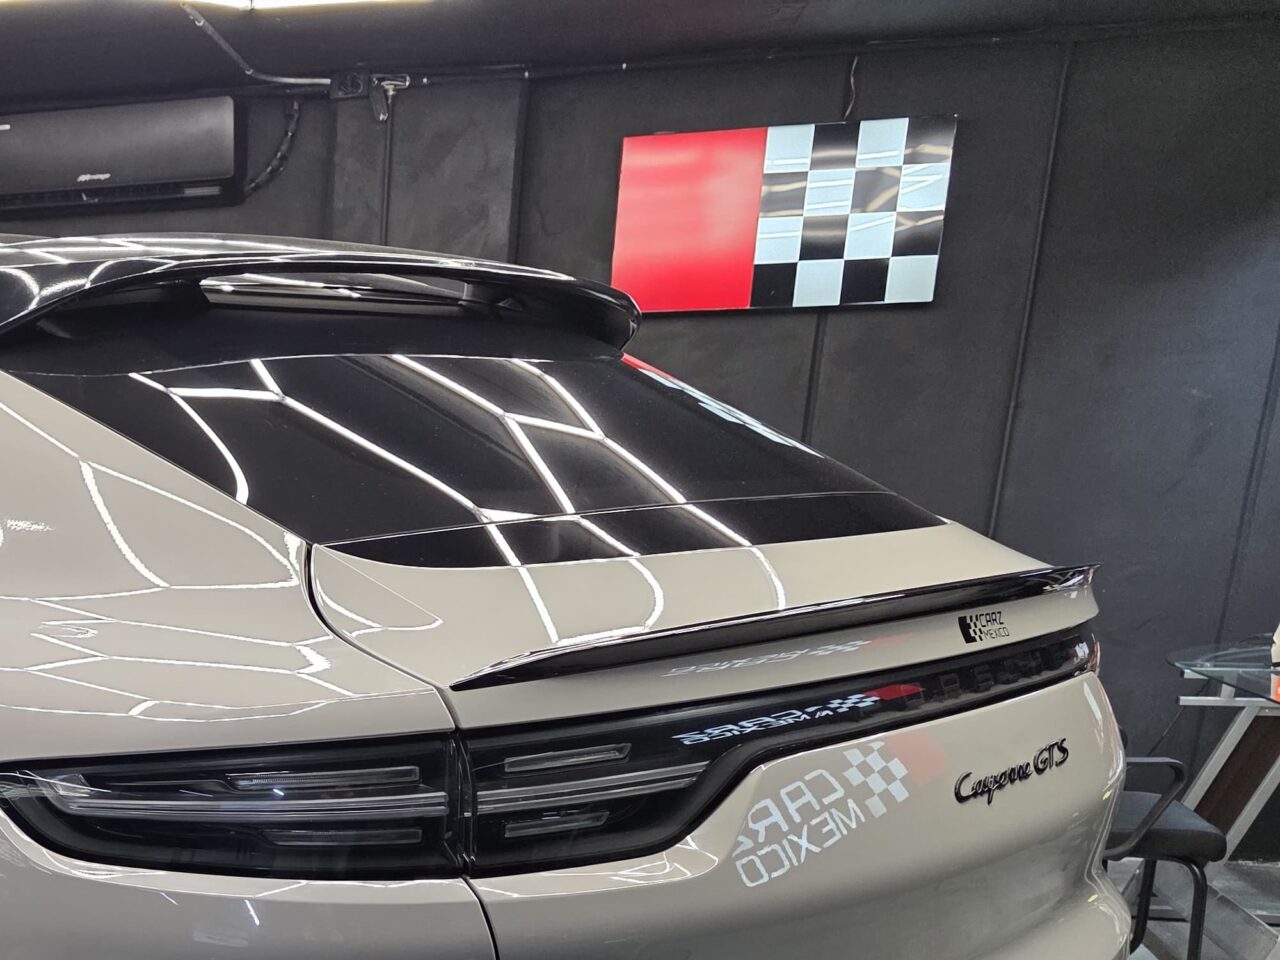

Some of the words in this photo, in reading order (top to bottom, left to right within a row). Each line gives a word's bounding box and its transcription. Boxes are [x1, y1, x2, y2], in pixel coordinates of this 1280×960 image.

[979, 611, 1004, 628] CARZ
[983, 627, 1010, 640] MEXICO
[954, 771, 1033, 806] Cayenne
[1033, 738, 1069, 775] GTS
